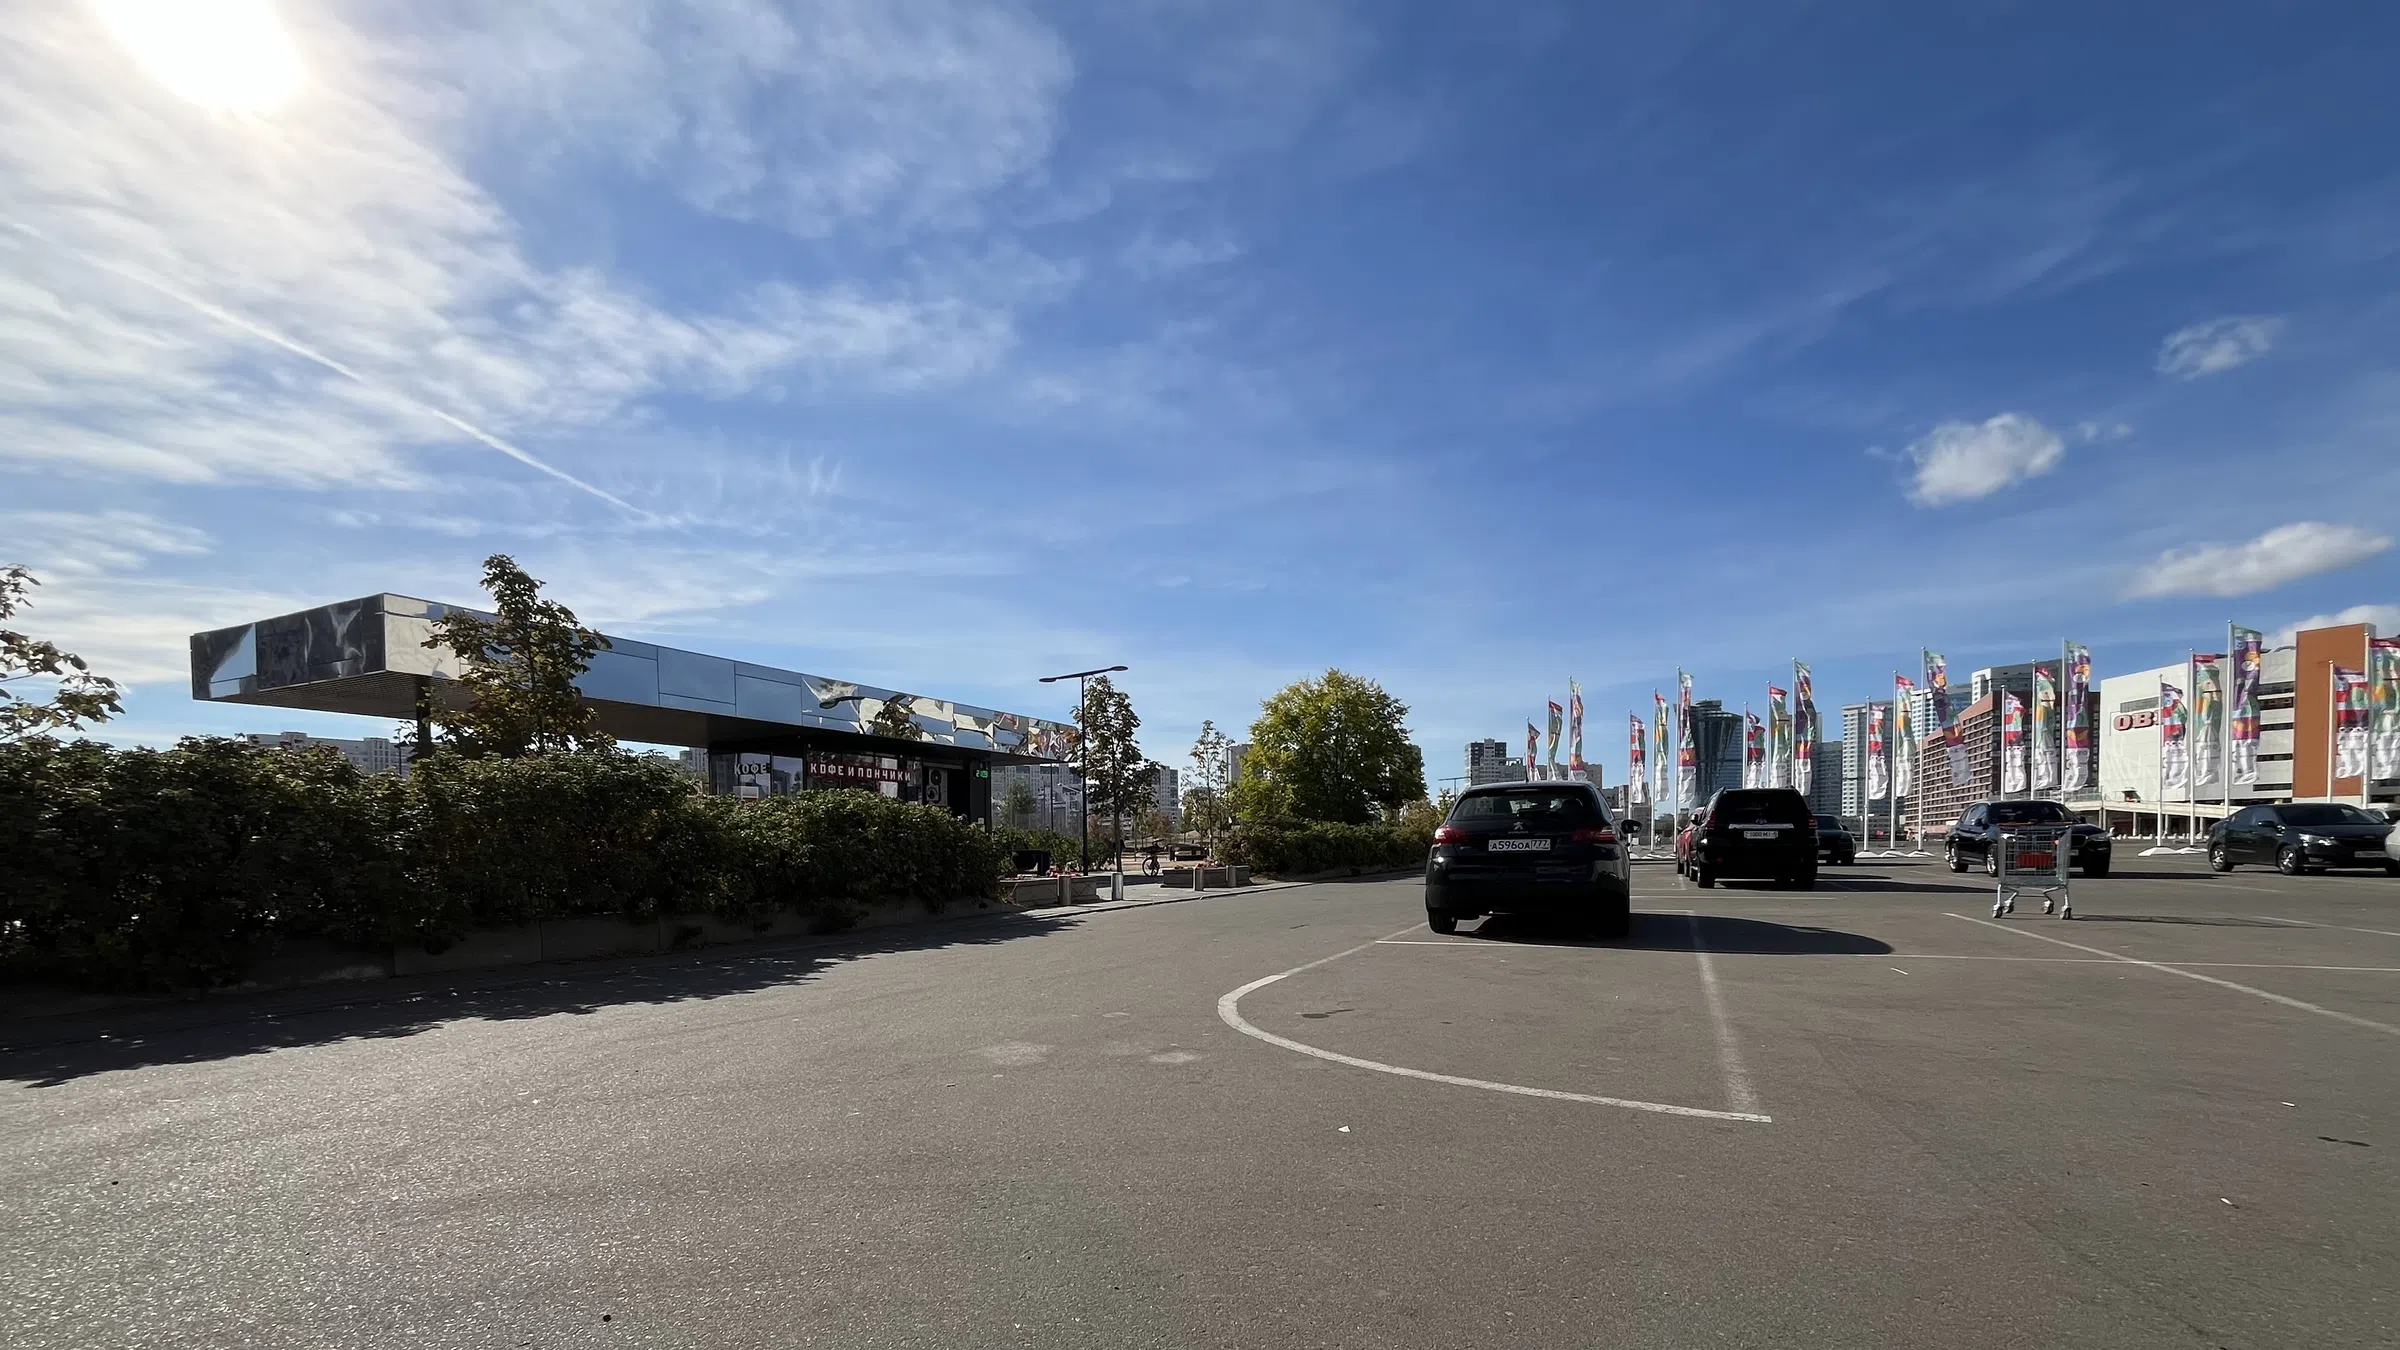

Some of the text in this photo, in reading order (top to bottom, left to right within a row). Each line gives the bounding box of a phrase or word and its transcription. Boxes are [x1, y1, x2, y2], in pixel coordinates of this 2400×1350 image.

[734, 763, 767, 776] КОФЕ
[810, 762, 911, 781] КОФЕ И ПОНЧИКИ
